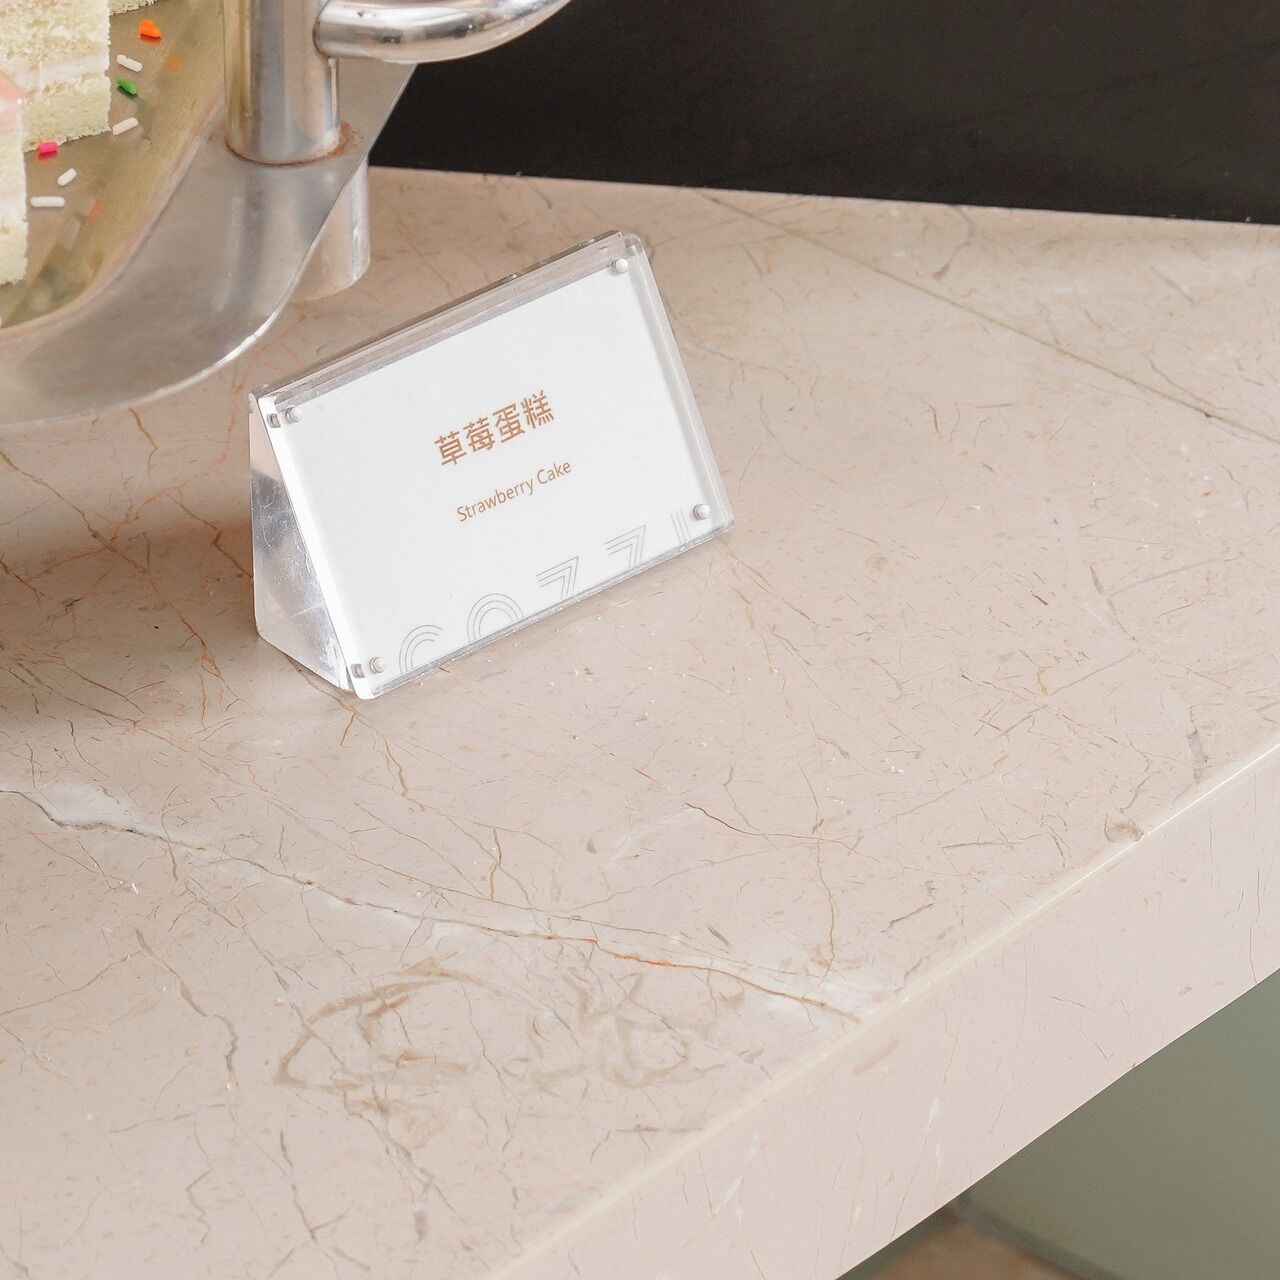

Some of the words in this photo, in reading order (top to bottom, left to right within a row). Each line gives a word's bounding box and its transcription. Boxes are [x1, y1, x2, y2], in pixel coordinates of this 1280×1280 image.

[434, 390, 554, 465] 草莓蛋糕
[457, 478, 534, 522] Strawberry
[537, 461, 572, 485] Cake
